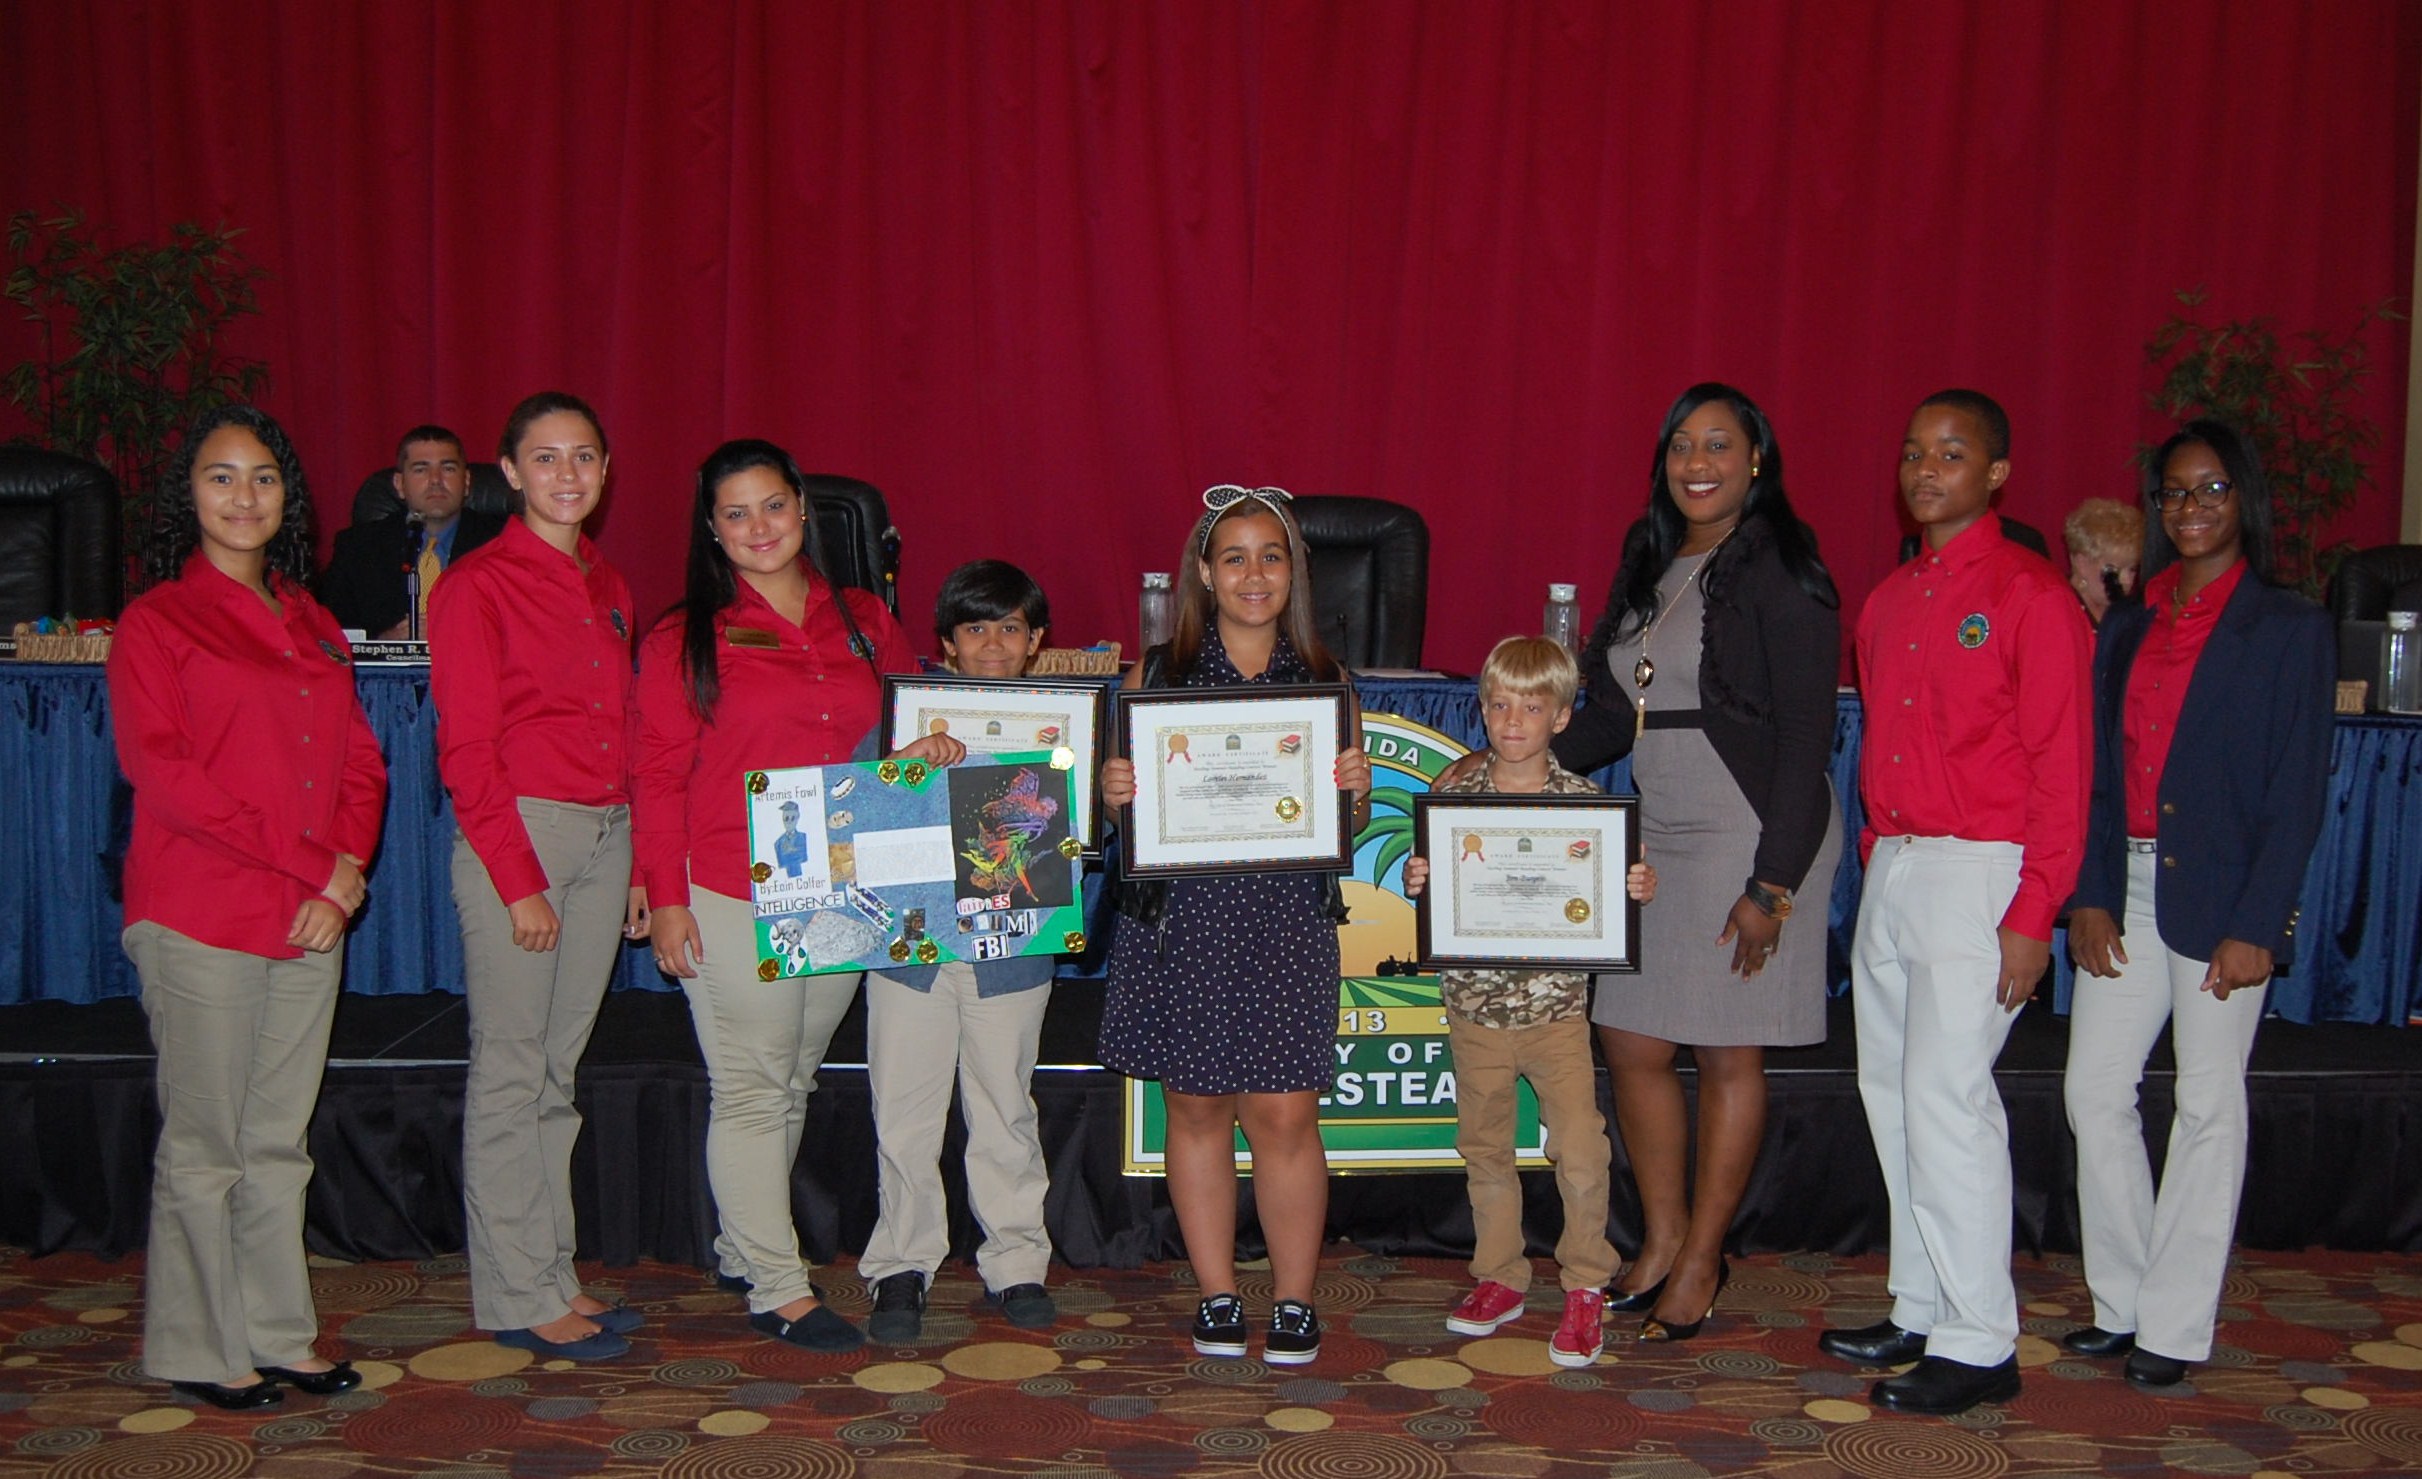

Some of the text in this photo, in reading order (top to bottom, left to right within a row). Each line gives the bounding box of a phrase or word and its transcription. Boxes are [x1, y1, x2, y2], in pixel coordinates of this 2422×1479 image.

[352, 644, 404, 656] Stephen
[407, 645, 421, 654] R.
[795, 784, 817, 798] Fowl
[754, 893, 841, 916] INTELLIGENCE
[973, 934, 1008, 960] FBI
[1387, 1042, 1443, 1065] OF
